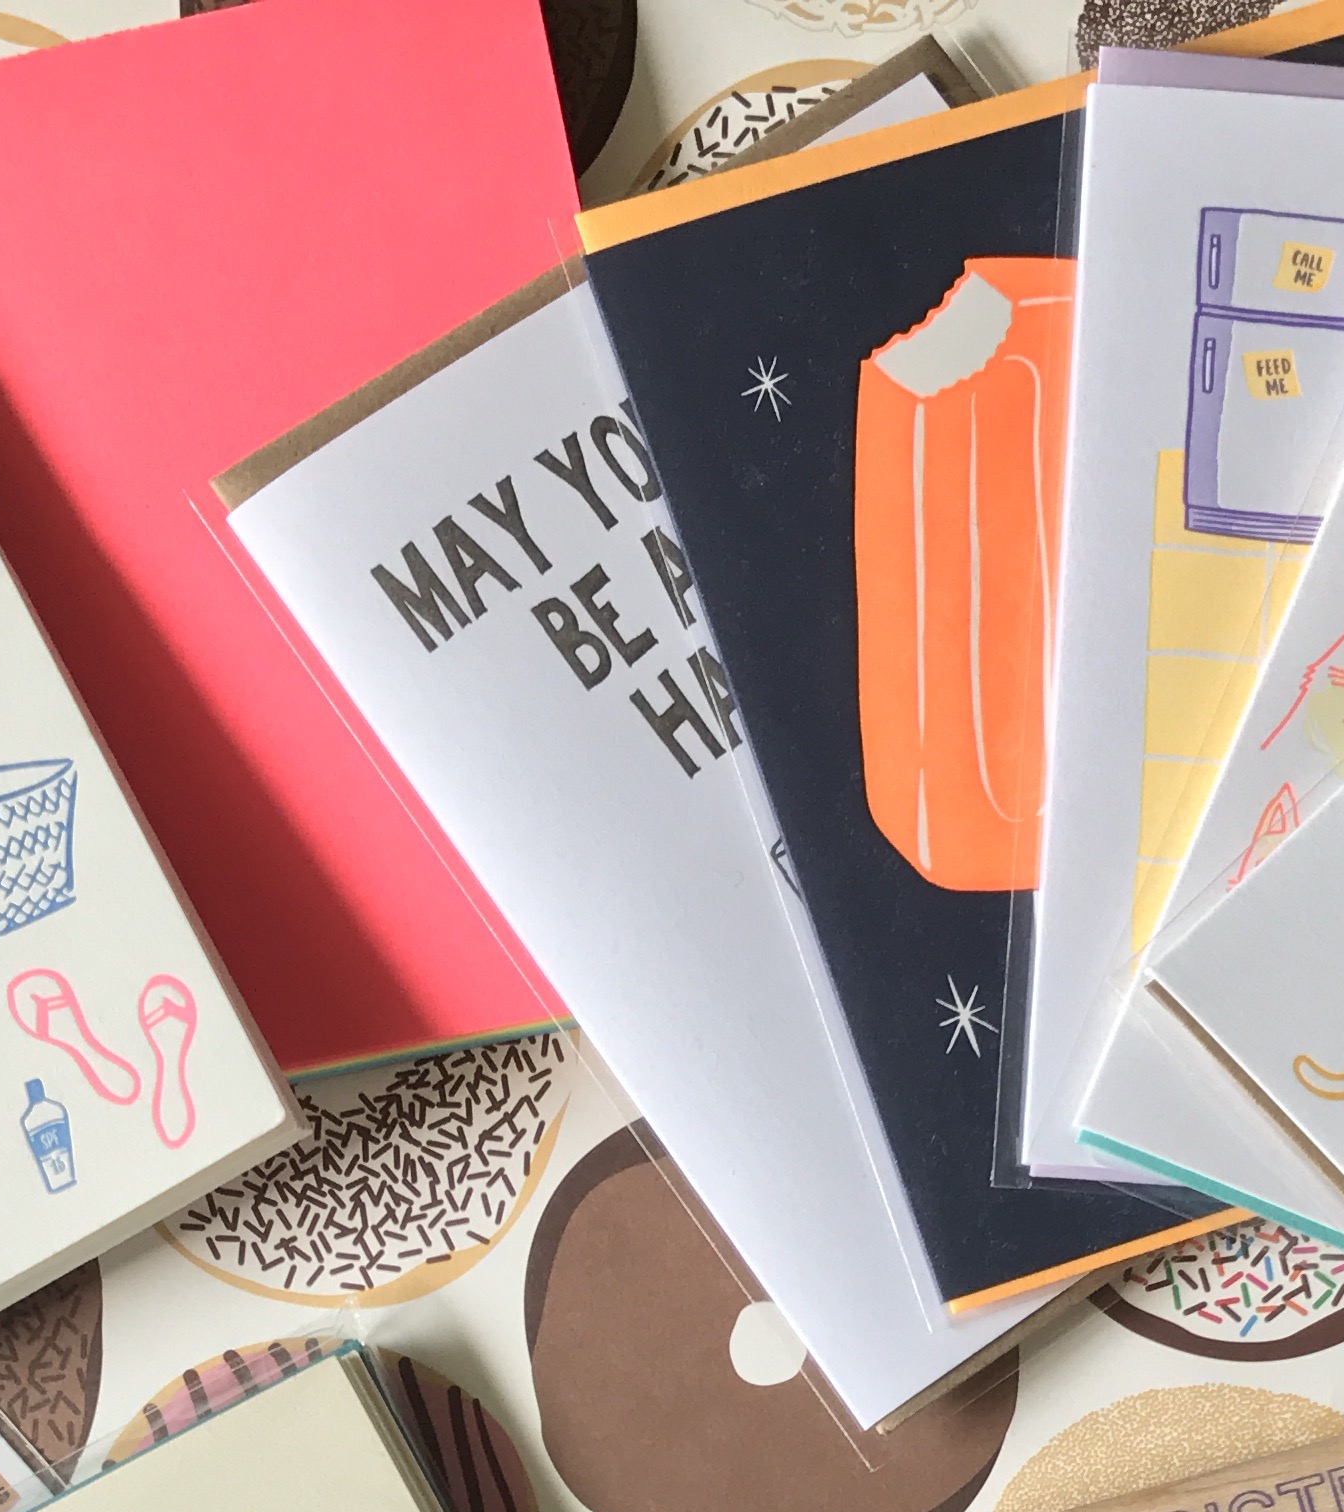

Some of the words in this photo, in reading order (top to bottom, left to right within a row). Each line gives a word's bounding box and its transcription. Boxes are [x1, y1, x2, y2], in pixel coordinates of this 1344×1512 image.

[1291, 250, 1324, 272] CALL
[1293, 271, 1315, 288] ME
[1256, 358, 1291, 377] FEED
[1265, 378, 1288, 395] ME
[371, 476, 552, 653] MAY
[534, 398, 663, 530] YO
[532, 564, 658, 691] BE
